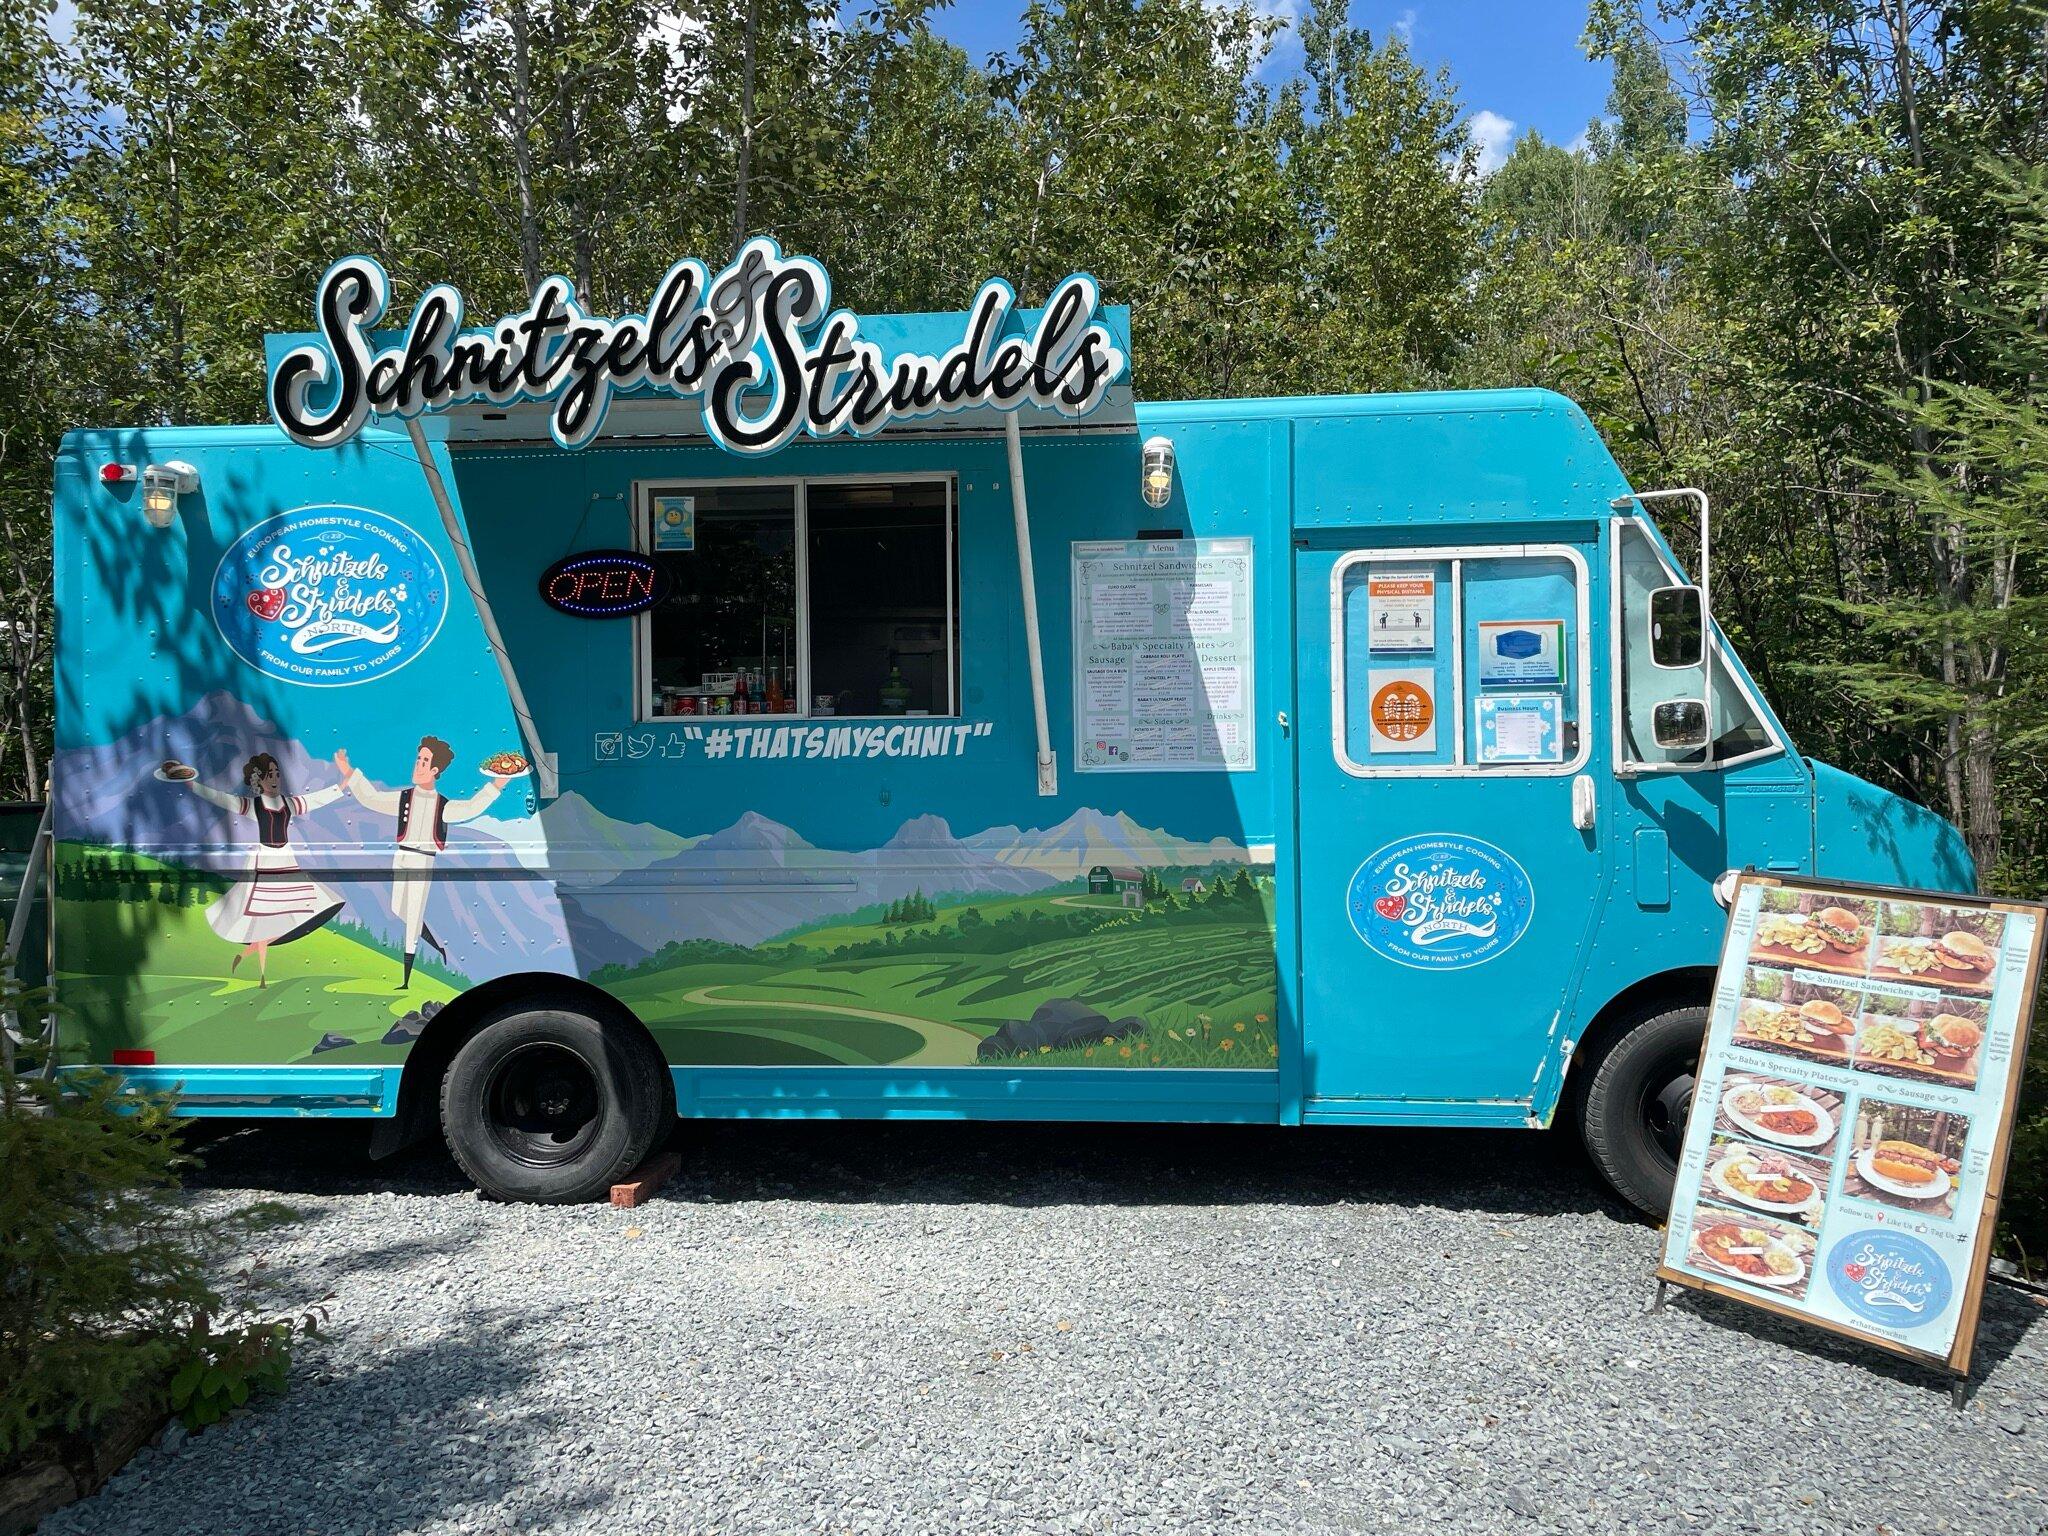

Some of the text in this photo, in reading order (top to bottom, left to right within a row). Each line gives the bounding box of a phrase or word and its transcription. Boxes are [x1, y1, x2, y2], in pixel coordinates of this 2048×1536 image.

[273, 266, 724, 436] Schnitzels
[711, 266, 1111, 446] Strudels
[248, 517, 408, 559] EUROPEAN HOMESTYLE COOKING
[1152, 544, 1175, 552] Menu
[260, 544, 389, 590] Schnitzels
[1113, 561, 1213, 571] Schnitzel Sandwiches
[334, 577, 350, 601] &
[549, 569, 656, 601] OPEN
[279, 583, 397, 629] Strudels
[306, 622, 365, 637] NORTH
[1111, 640, 1215, 653] Baba's Specialty Plates
[261, 645, 402, 677] FROM OUR FAMILY TO YOURS
[1089, 656, 1126, 666] Sausage
[1201, 654, 1237, 662] Dessert
[1206, 712, 1232, 720] Drinks
[1374, 842, 1501, 874] EUROPEAN HOMESTYLE COOKING
[1386, 863, 1487, 897] Schnitzels
[1444, 887, 1457, 905] &
[1401, 891, 1493, 926] Strudels
[1423, 920, 1469, 932] NORTH
[1388, 939, 1499, 963] FROM OUR FAMILY TO YOURS
[1818, 975, 1914, 996] Schnitzel Sandwiches
[1738, 1055, 1840, 1083] Baba's Specialty Plates
[1898, 1087, 1936, 1101] Sausage
[1839, 1206, 1874, 1221] Follow Us
[1886, 1218, 1913, 1230] Like Us
[1930, 1228, 1944, 1239] Tag
[1945, 1232, 1955, 1240] Us
[1854, 1244, 1924, 1278] Schnitzels
[1860, 1266, 1926, 1298] Strudels
